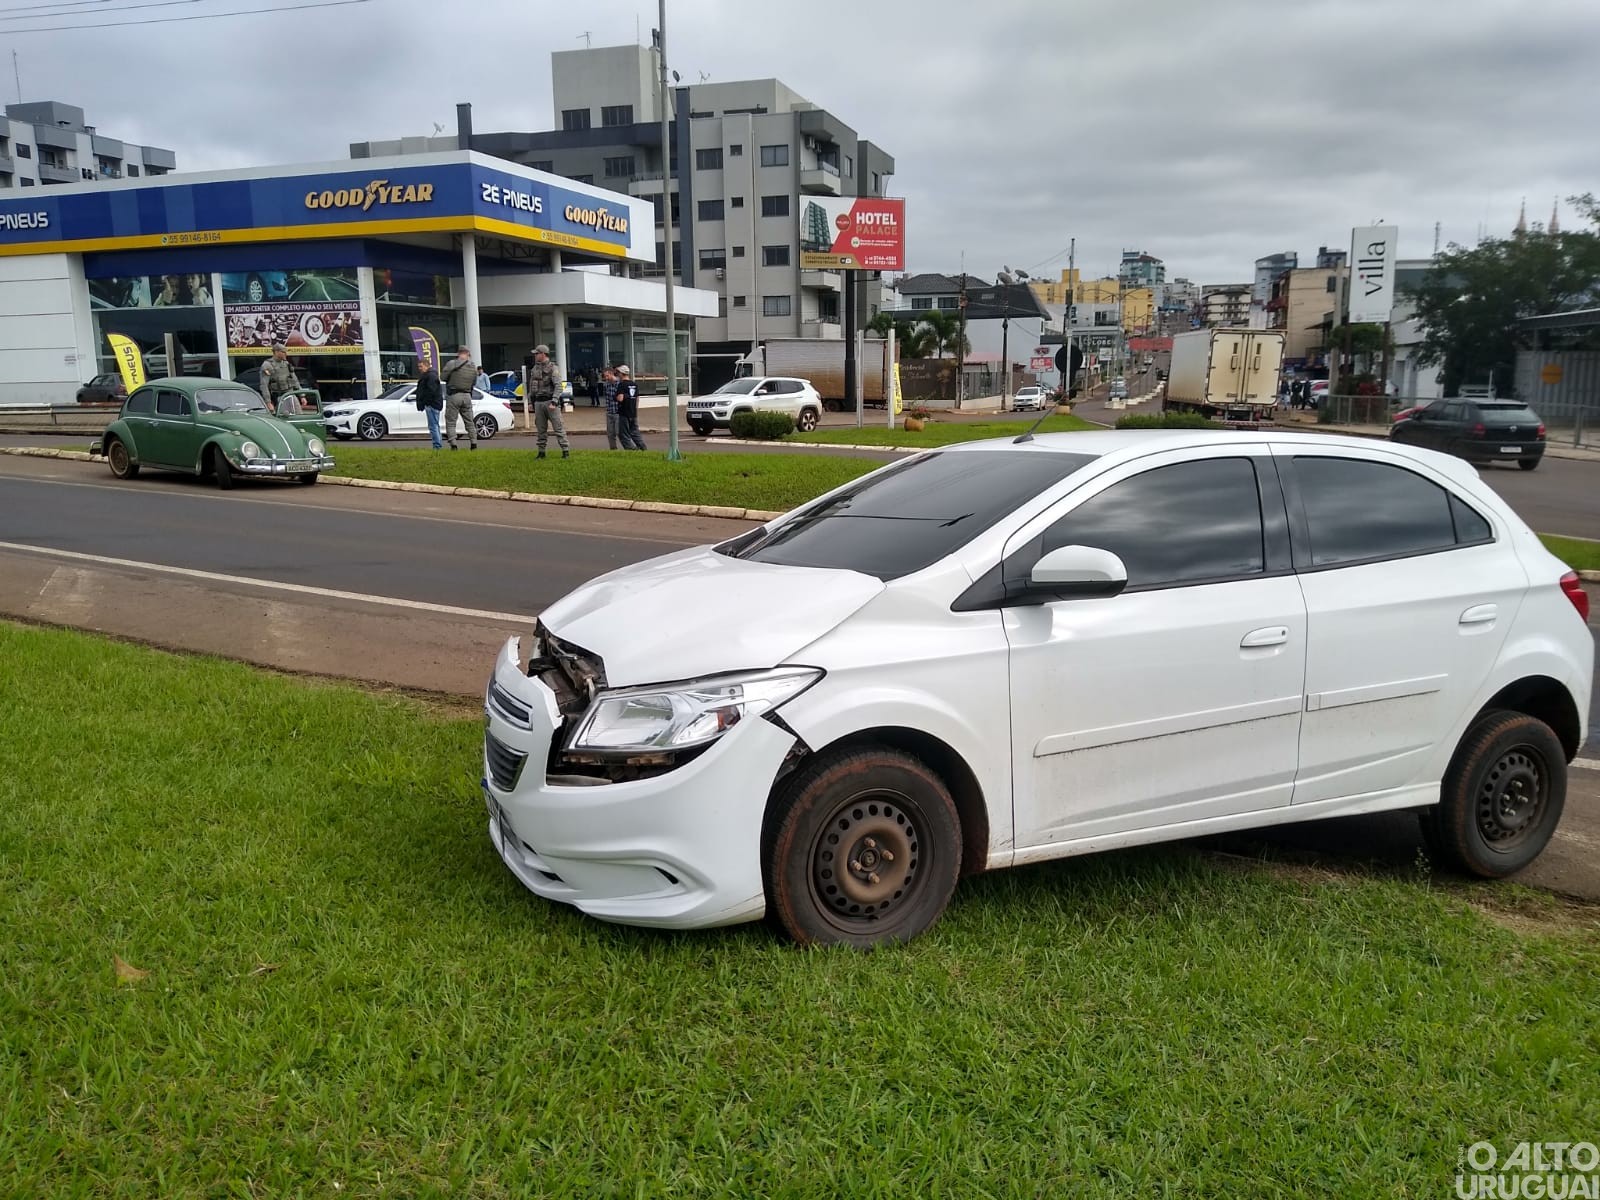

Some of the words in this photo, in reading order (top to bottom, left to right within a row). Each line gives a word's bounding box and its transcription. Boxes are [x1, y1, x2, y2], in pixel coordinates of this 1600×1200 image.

[305, 182, 433, 209] GOODYEAR
[482, 183, 500, 204] ZÉ
[503, 188, 543, 213] PNEUS
[0, 211, 49, 230] PNEUS
[565, 205, 628, 233] GOODYEAR
[855, 225, 898, 236] PALACE
[856, 212, 897, 225] HOTEL
[1358, 241, 1386, 297] villa
